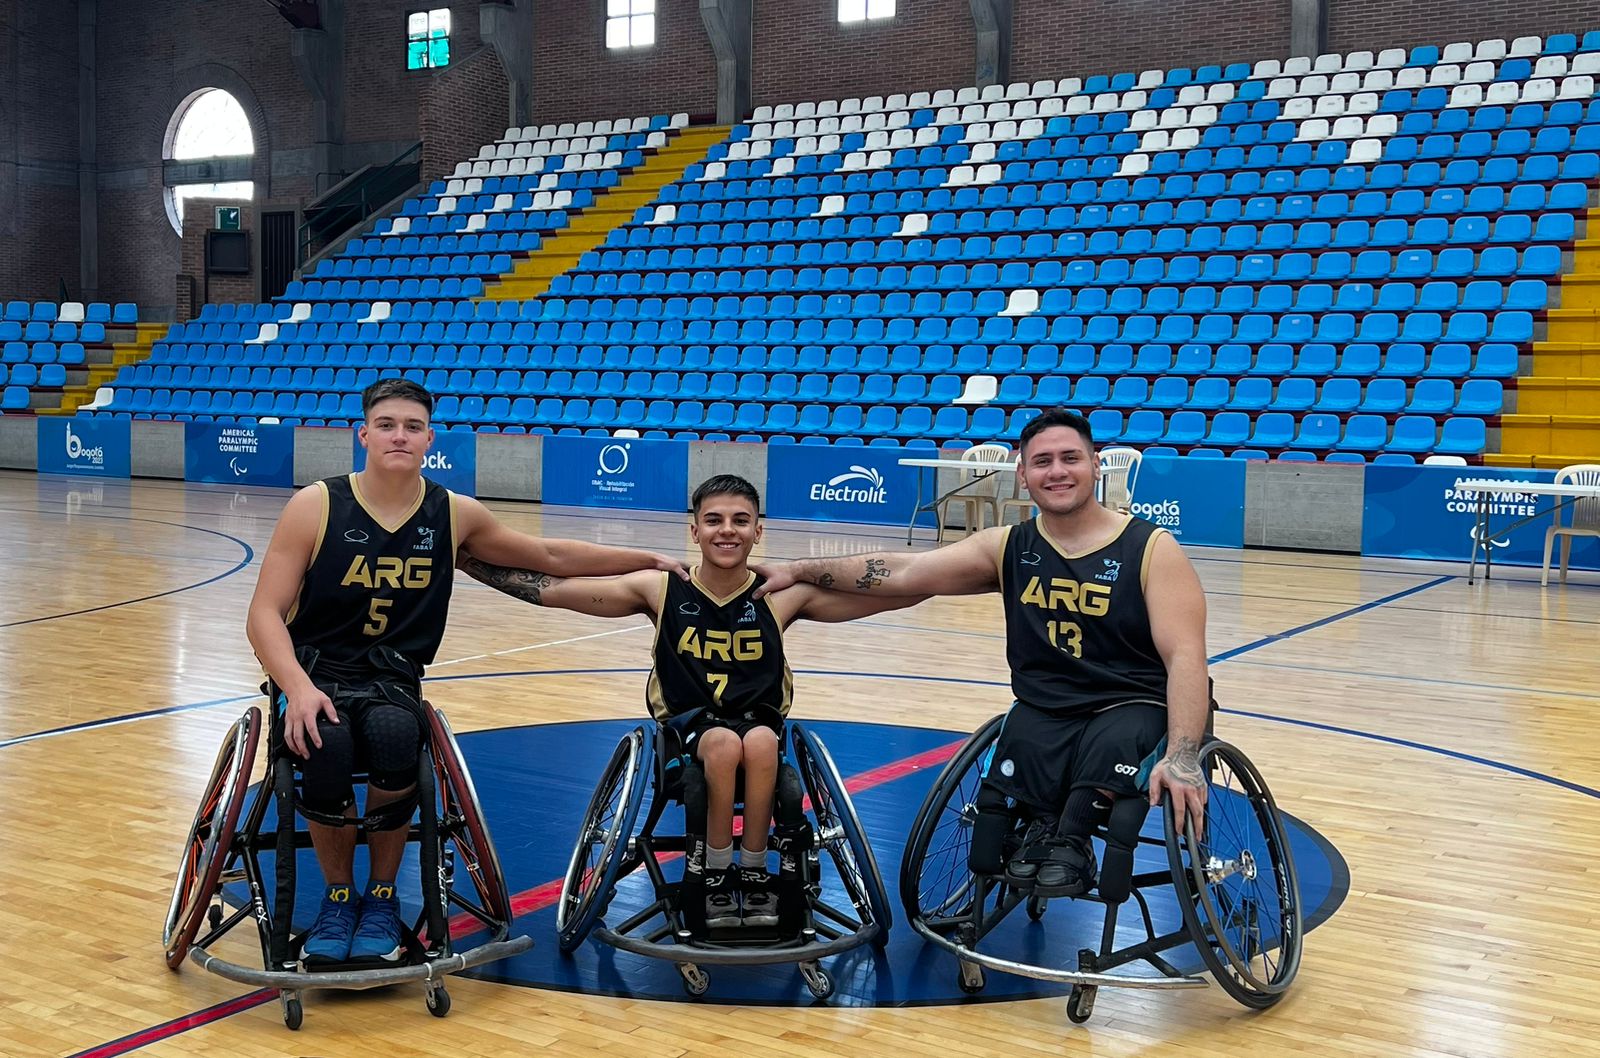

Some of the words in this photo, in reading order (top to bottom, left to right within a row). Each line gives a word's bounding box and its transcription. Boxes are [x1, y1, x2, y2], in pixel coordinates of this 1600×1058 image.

[218, 436, 258, 445] PARALYMPIC
[222, 429, 254, 437] AMERICAS
[219, 444, 257, 453] COMMITTEE
[810, 483, 887, 504] Electrolit
[1155, 515, 1180, 526] 2023
[1446, 501, 1536, 517] COMMITTEE
[340, 554, 433, 589] ARG
[1020, 575, 1112, 617] ARG
[362, 597, 393, 636] 5
[677, 626, 763, 662] ARG
[1046, 620, 1083, 659] 13
[706, 672, 729, 707] 7
